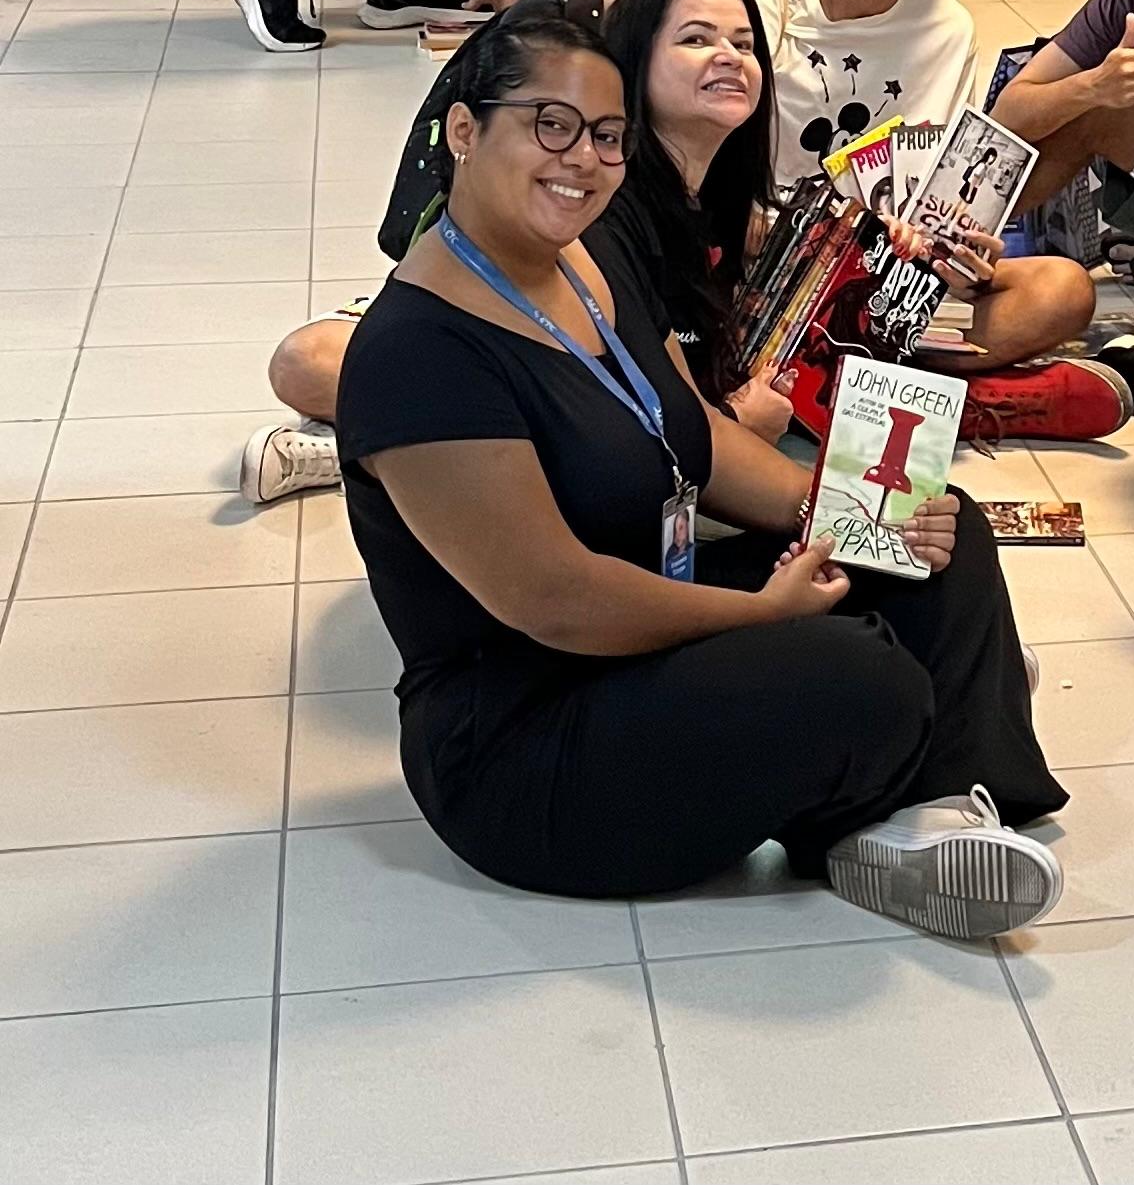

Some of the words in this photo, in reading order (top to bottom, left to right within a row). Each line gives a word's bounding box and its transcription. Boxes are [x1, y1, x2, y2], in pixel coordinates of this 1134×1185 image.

[848, 368, 898, 399] JOHN
[900, 383, 960, 419] GREEN
[840, 533, 929, 570] PAPEL
